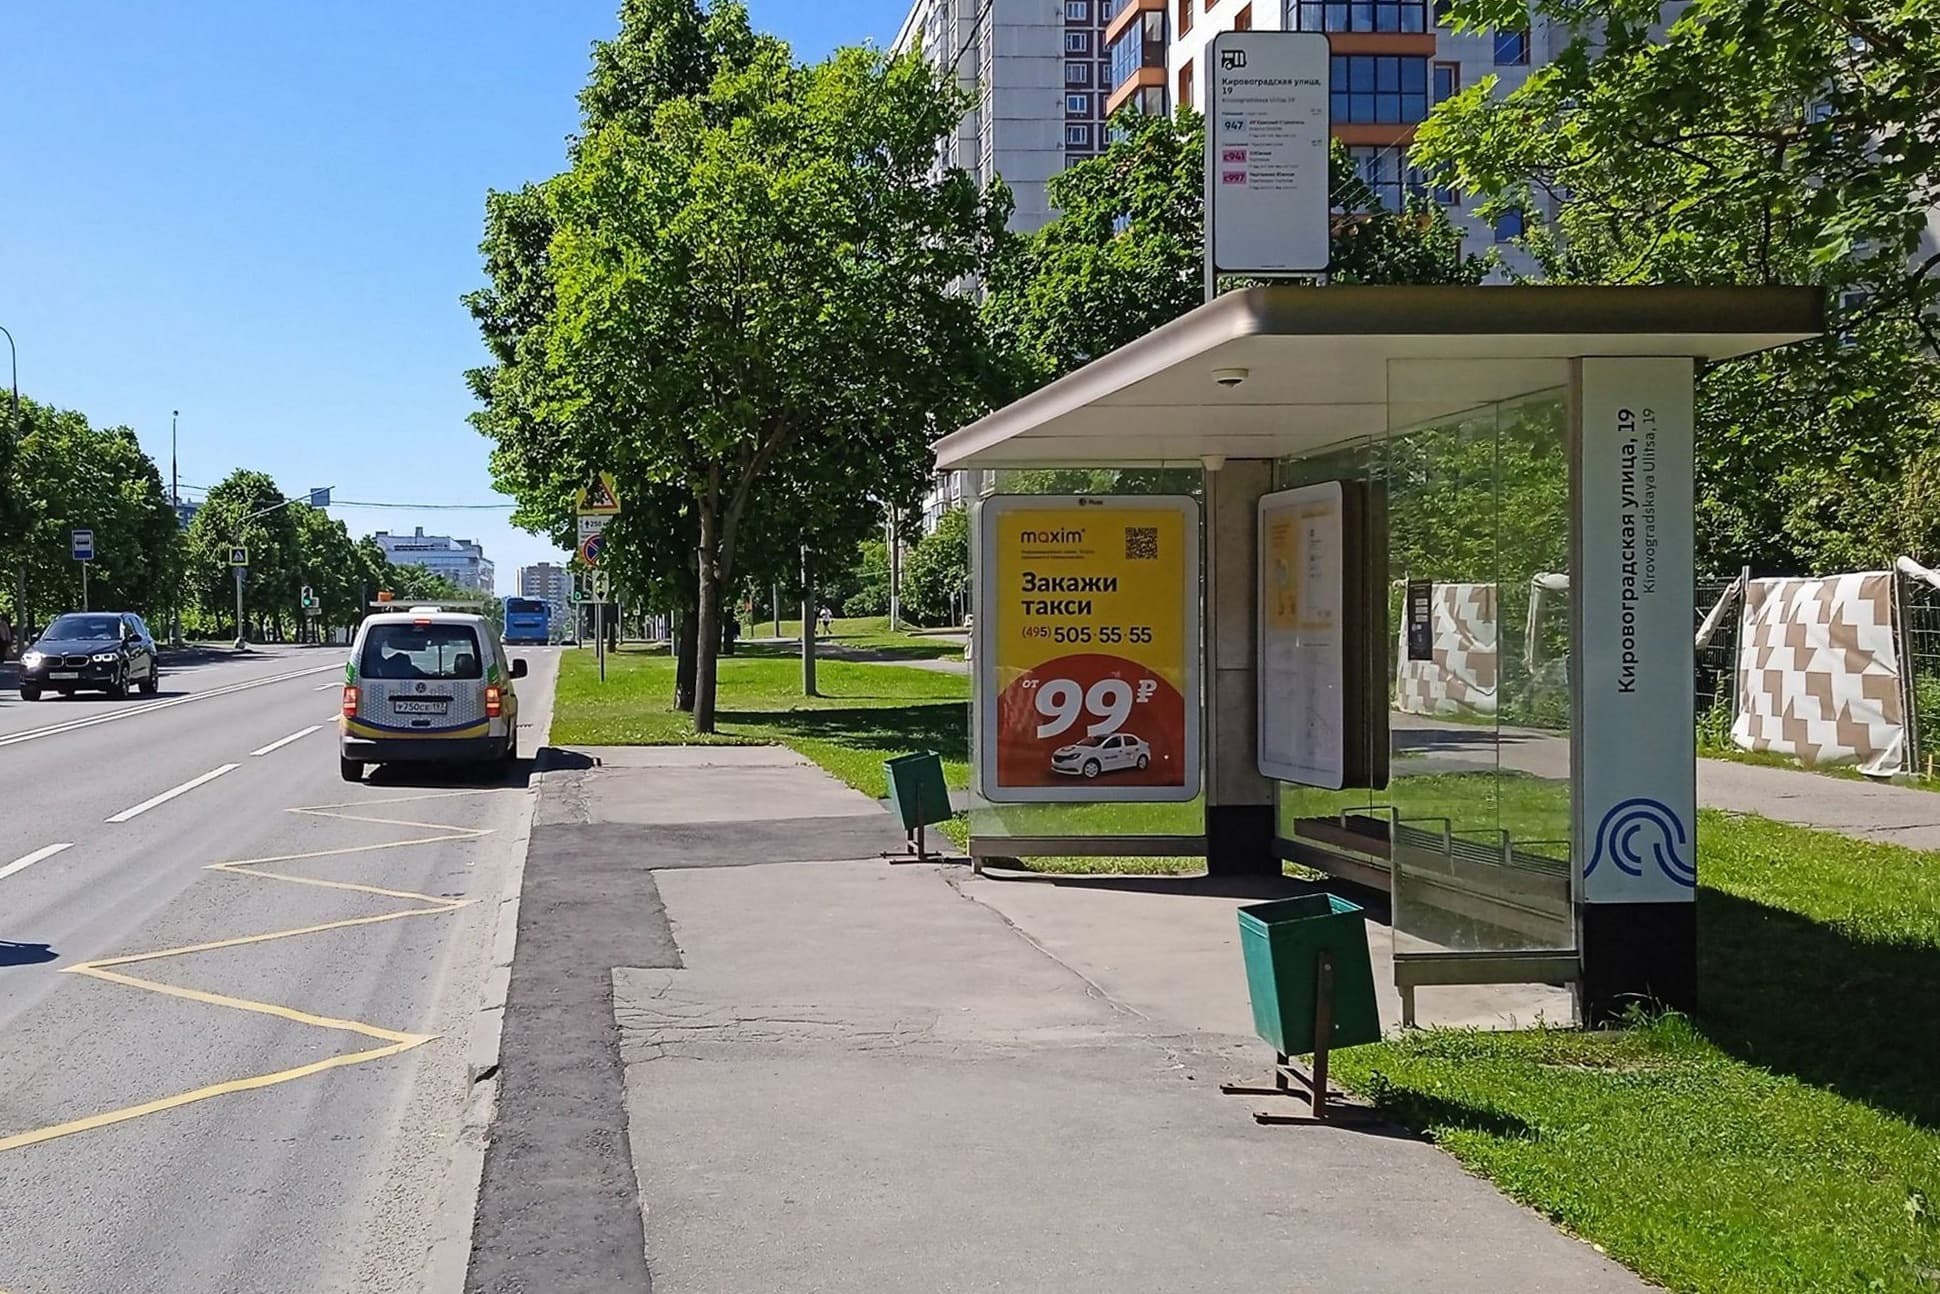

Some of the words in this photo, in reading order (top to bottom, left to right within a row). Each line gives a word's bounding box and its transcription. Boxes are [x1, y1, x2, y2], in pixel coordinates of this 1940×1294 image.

[1222, 78, 1293, 87] Кировоградская
[1224, 121, 1244, 130] 947
[1618, 408, 1635, 432] 19
[1643, 408, 1656, 425] 19
[1643, 428, 1657, 472] Ulitsa,
[1620, 438, 1639, 509] улица,
[1021, 526, 1082, 543] maxim
[1643, 475, 1658, 594] Kirovogradskaya
[1022, 571, 1118, 592] Закажи
[1021, 600, 1092, 615] такси
[1618, 513, 1639, 693] Кировоградская
[1022, 625, 1052, 638] (495)
[1022, 680, 1040, 688] от
[1035, 678, 1133, 739] 99
